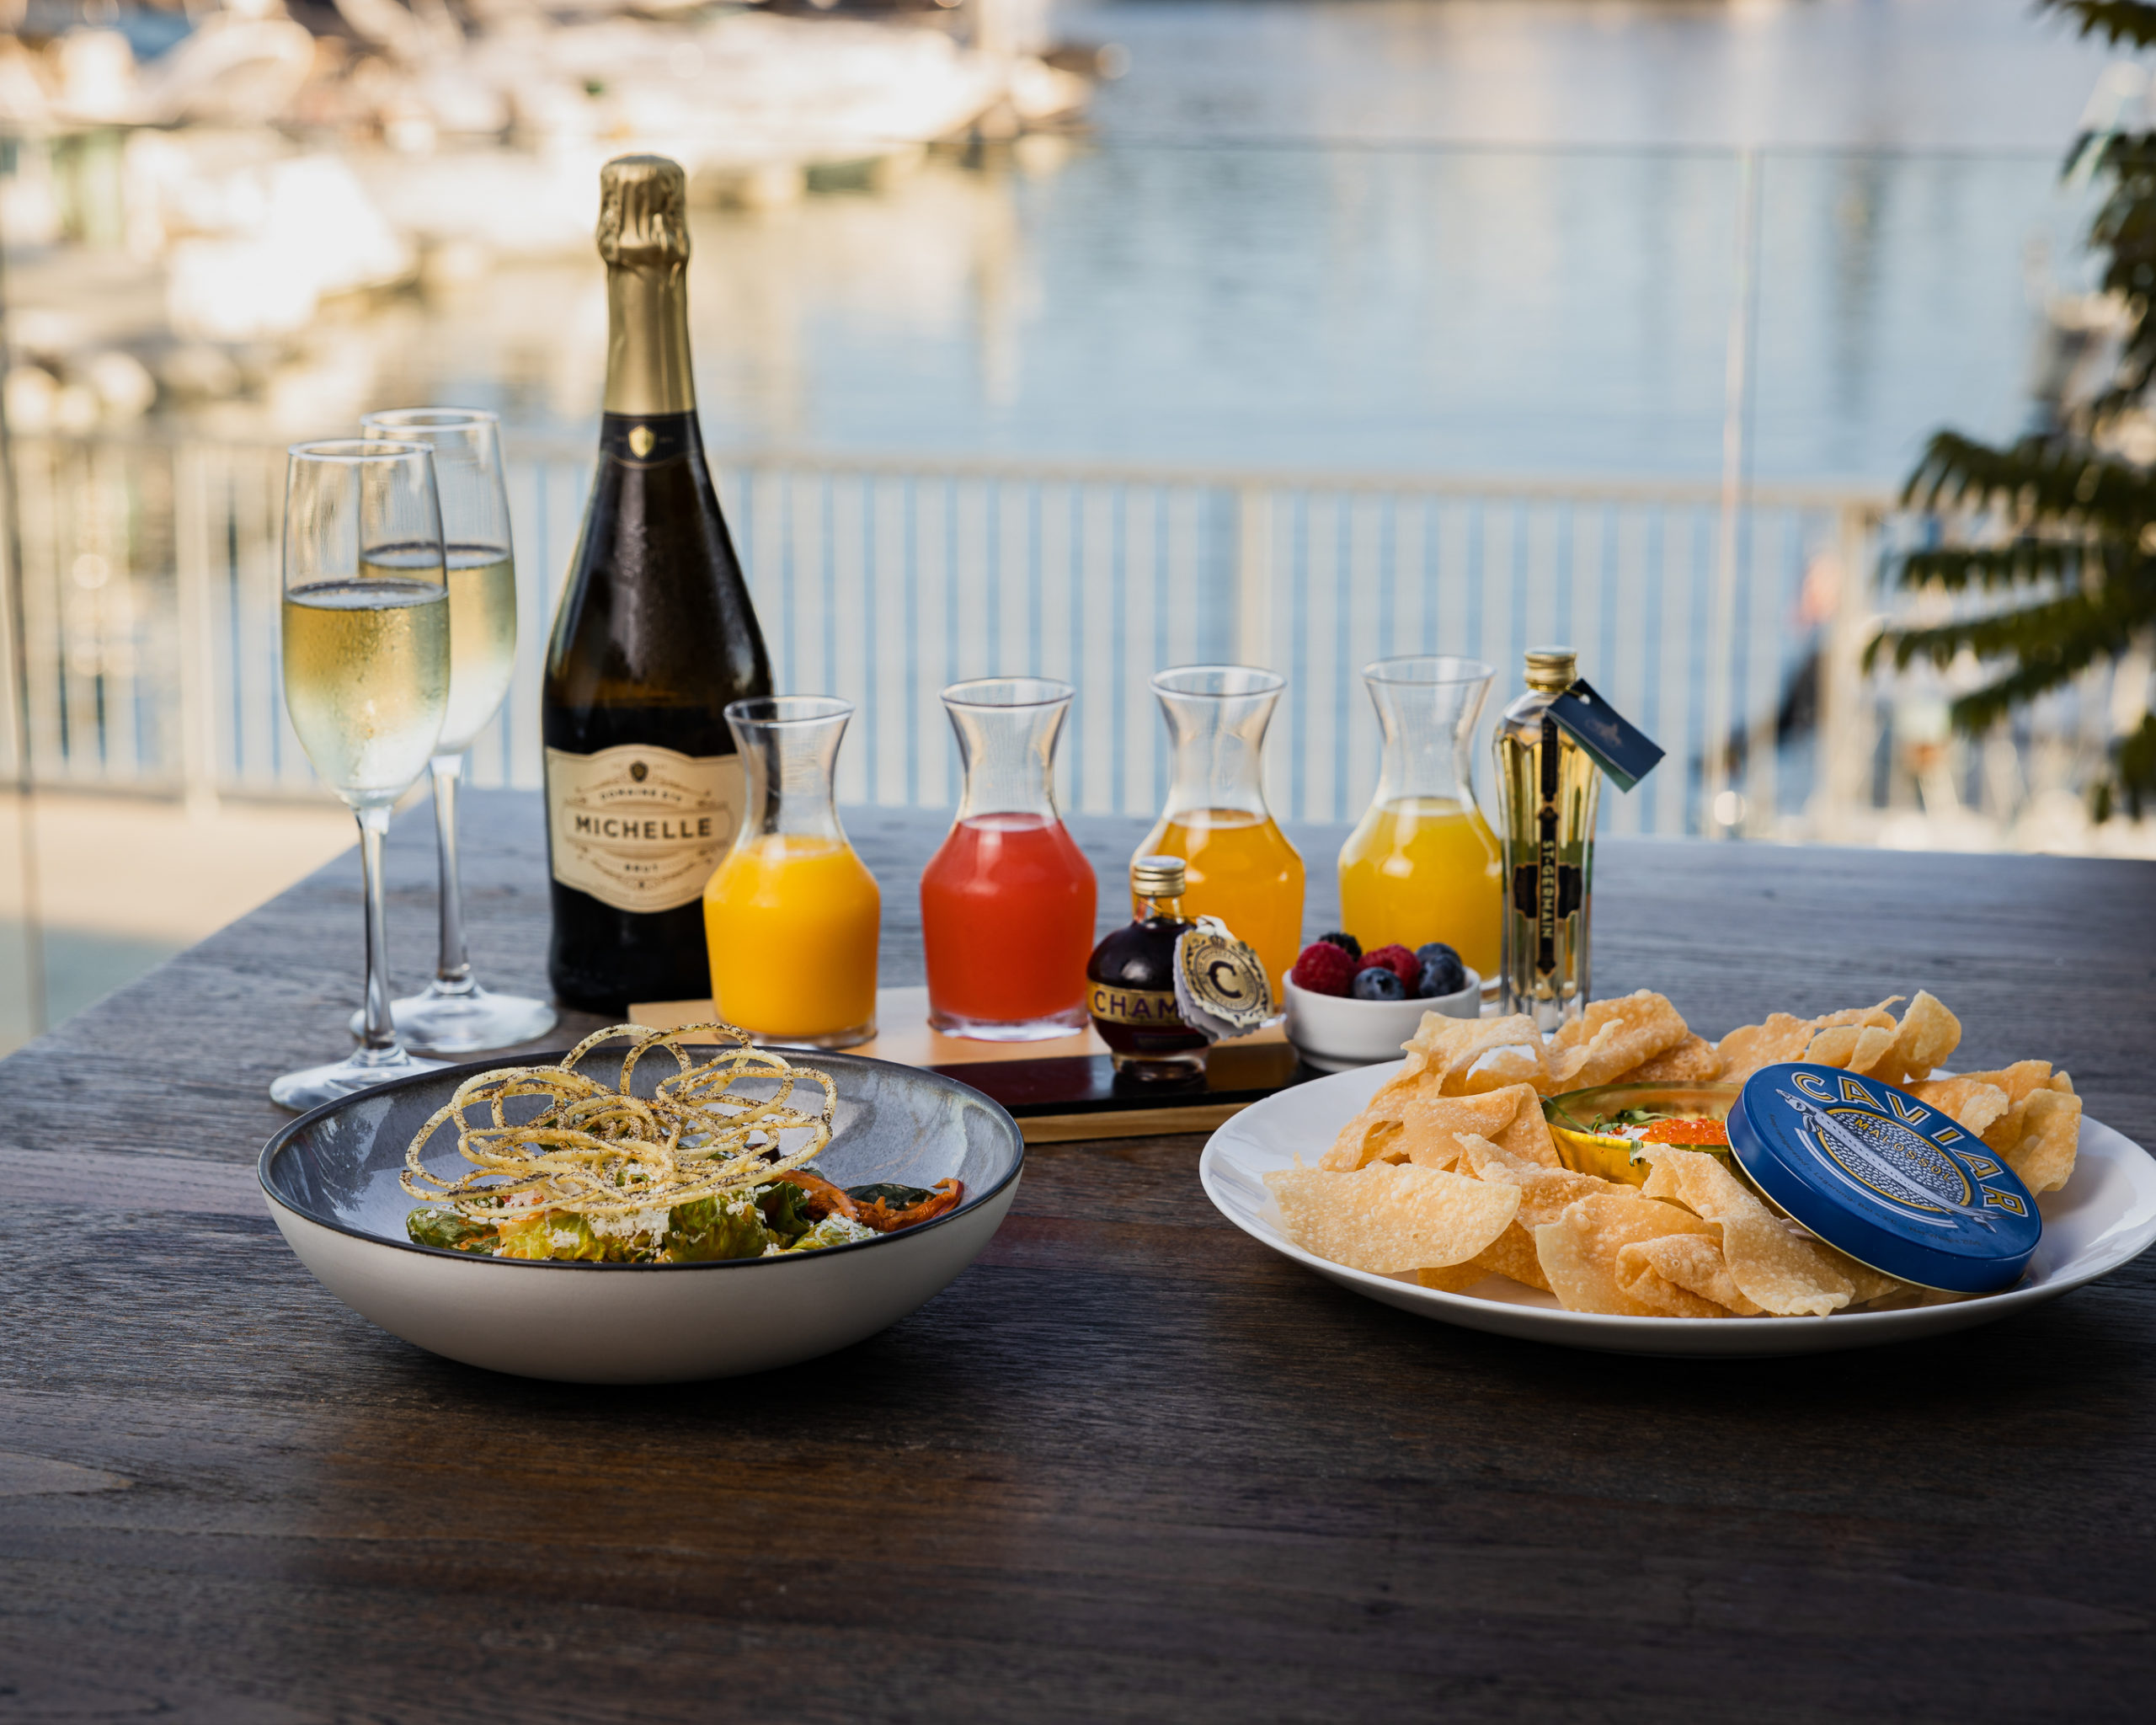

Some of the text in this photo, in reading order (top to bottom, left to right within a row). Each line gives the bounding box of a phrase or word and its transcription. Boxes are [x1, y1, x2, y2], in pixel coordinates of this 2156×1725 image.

[575, 815, 712, 840] MICHELLE
[1208, 960, 1243, 998] C
[1790, 1071, 2029, 1217] CAVIAR
[1854, 1119, 1955, 1183] MALOSSOL
